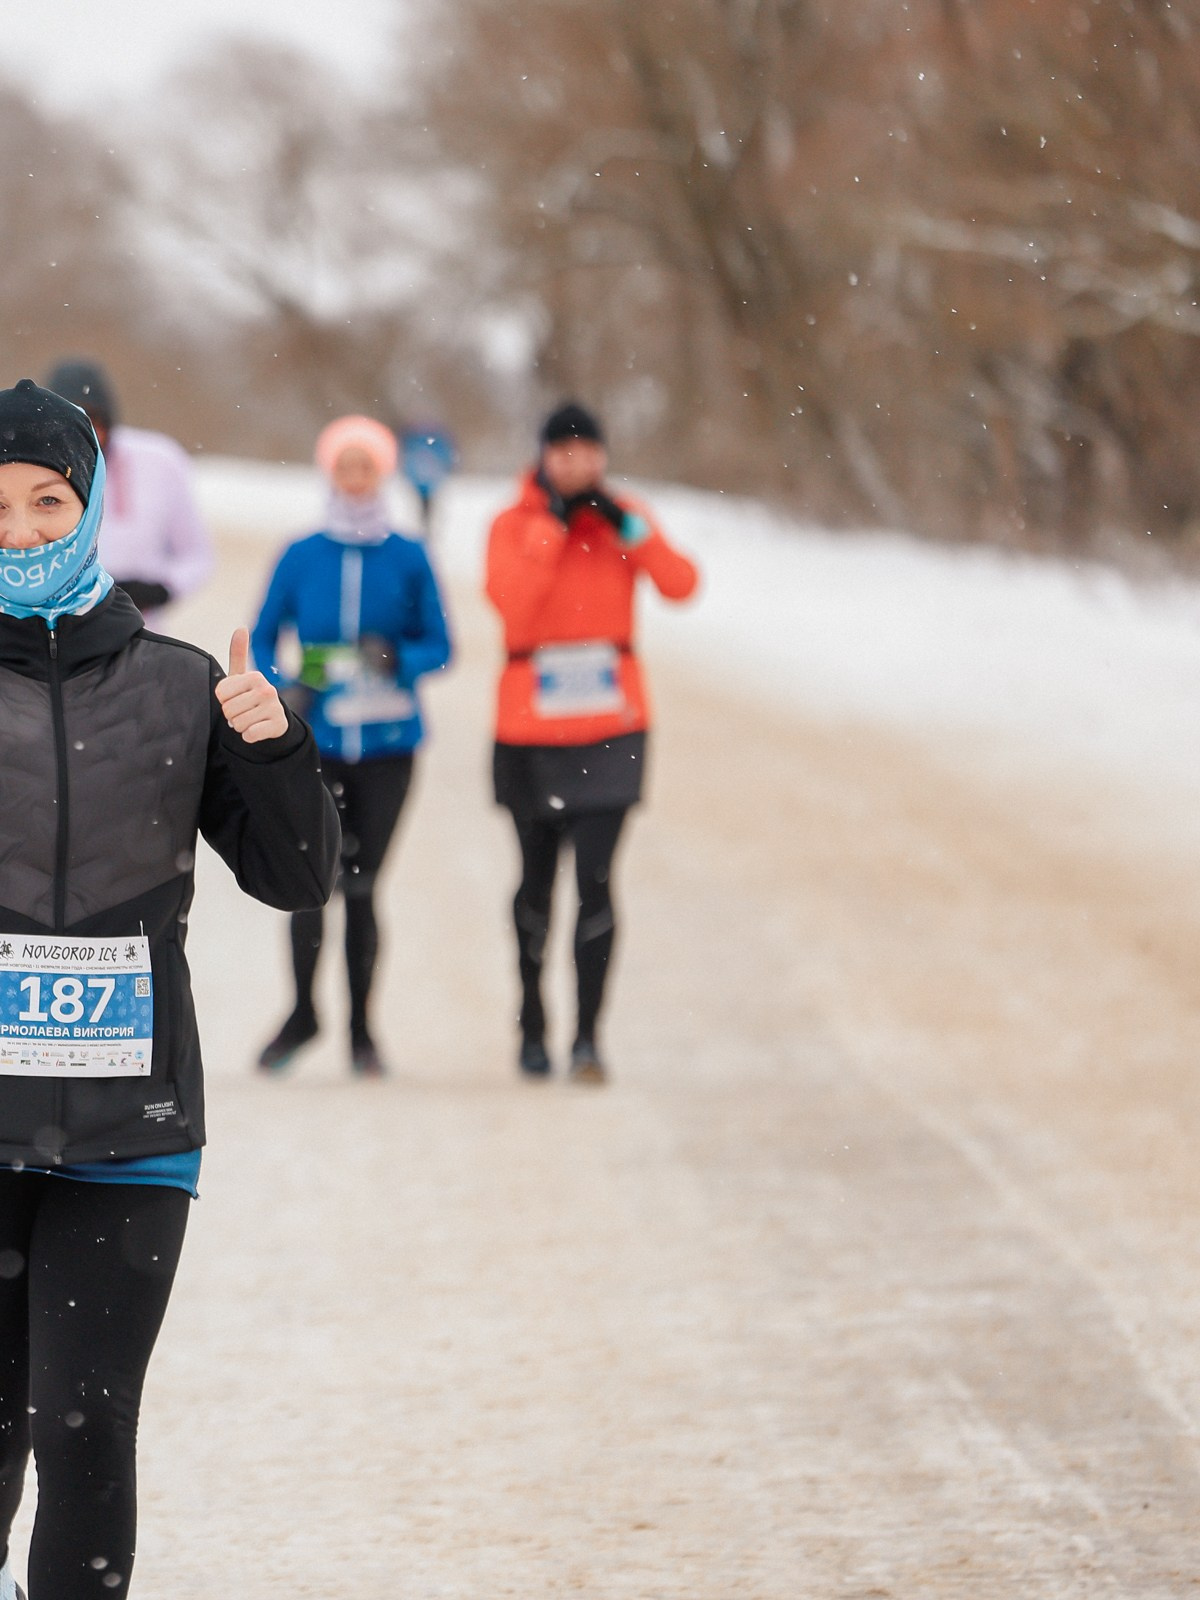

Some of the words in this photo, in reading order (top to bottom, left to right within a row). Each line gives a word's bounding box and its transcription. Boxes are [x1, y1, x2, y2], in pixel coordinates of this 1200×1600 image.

[22, 943, 95, 961] NOVGOROD
[98, 947, 118, 962] ICE
[18, 976, 116, 1024] 187
[74, 1026, 134, 1038] ВИКТОРИЯ
